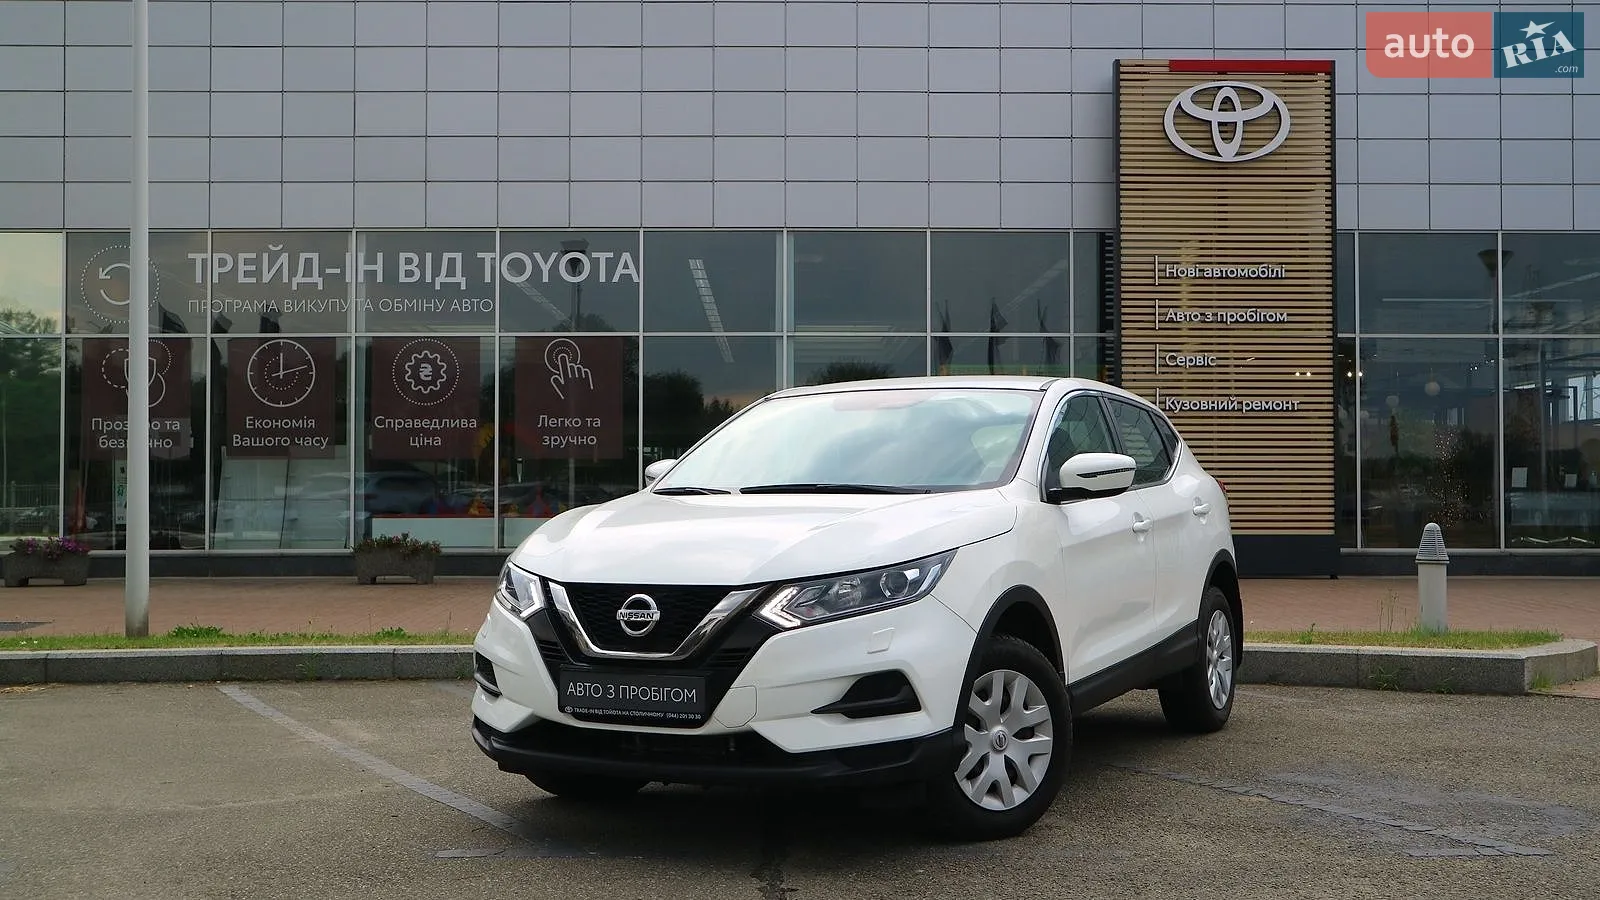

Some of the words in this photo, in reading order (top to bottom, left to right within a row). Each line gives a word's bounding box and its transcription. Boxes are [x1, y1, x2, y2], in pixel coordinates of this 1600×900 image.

[187, 244, 384, 290] ТРЕЙД-ІН
[399, 252, 466, 290] ВІД
[477, 251, 640, 283] TOYOTA
[1165, 264, 1199, 278] Нові
[1204, 264, 1286, 278] автомобілі
[188, 299, 279, 313] ПРОГРАМА
[284, 299, 350, 312] ВИКУПУ
[379, 298, 445, 312] ОБМІНУ
[450, 298, 494, 312] АВТО
[1165, 309, 1200, 323] Авто
[1204, 312, 1213, 323] з
[1217, 309, 1287, 325] пробігом
[1166, 352, 1217, 368] Сервіс
[1166, 396, 1238, 413] Кузовний
[1242, 401, 1299, 414] ремонт
[92, 418, 161, 433] Прозо
[164, 420, 181, 430] та
[245, 416, 316, 429] Економія
[374, 416, 477, 432] Справедлива
[537, 415, 582, 428] Легко
[586, 417, 601, 428] та
[232, 434, 292, 447] Вашого
[295, 436, 330, 449] часу
[409, 434, 442, 449] ціна
[542, 435, 597, 448] зручно
[619, 611, 654, 620] NISSAN
[567, 682, 603, 698] АВТО
[619, 685, 697, 703] ПРОБІГОМ
